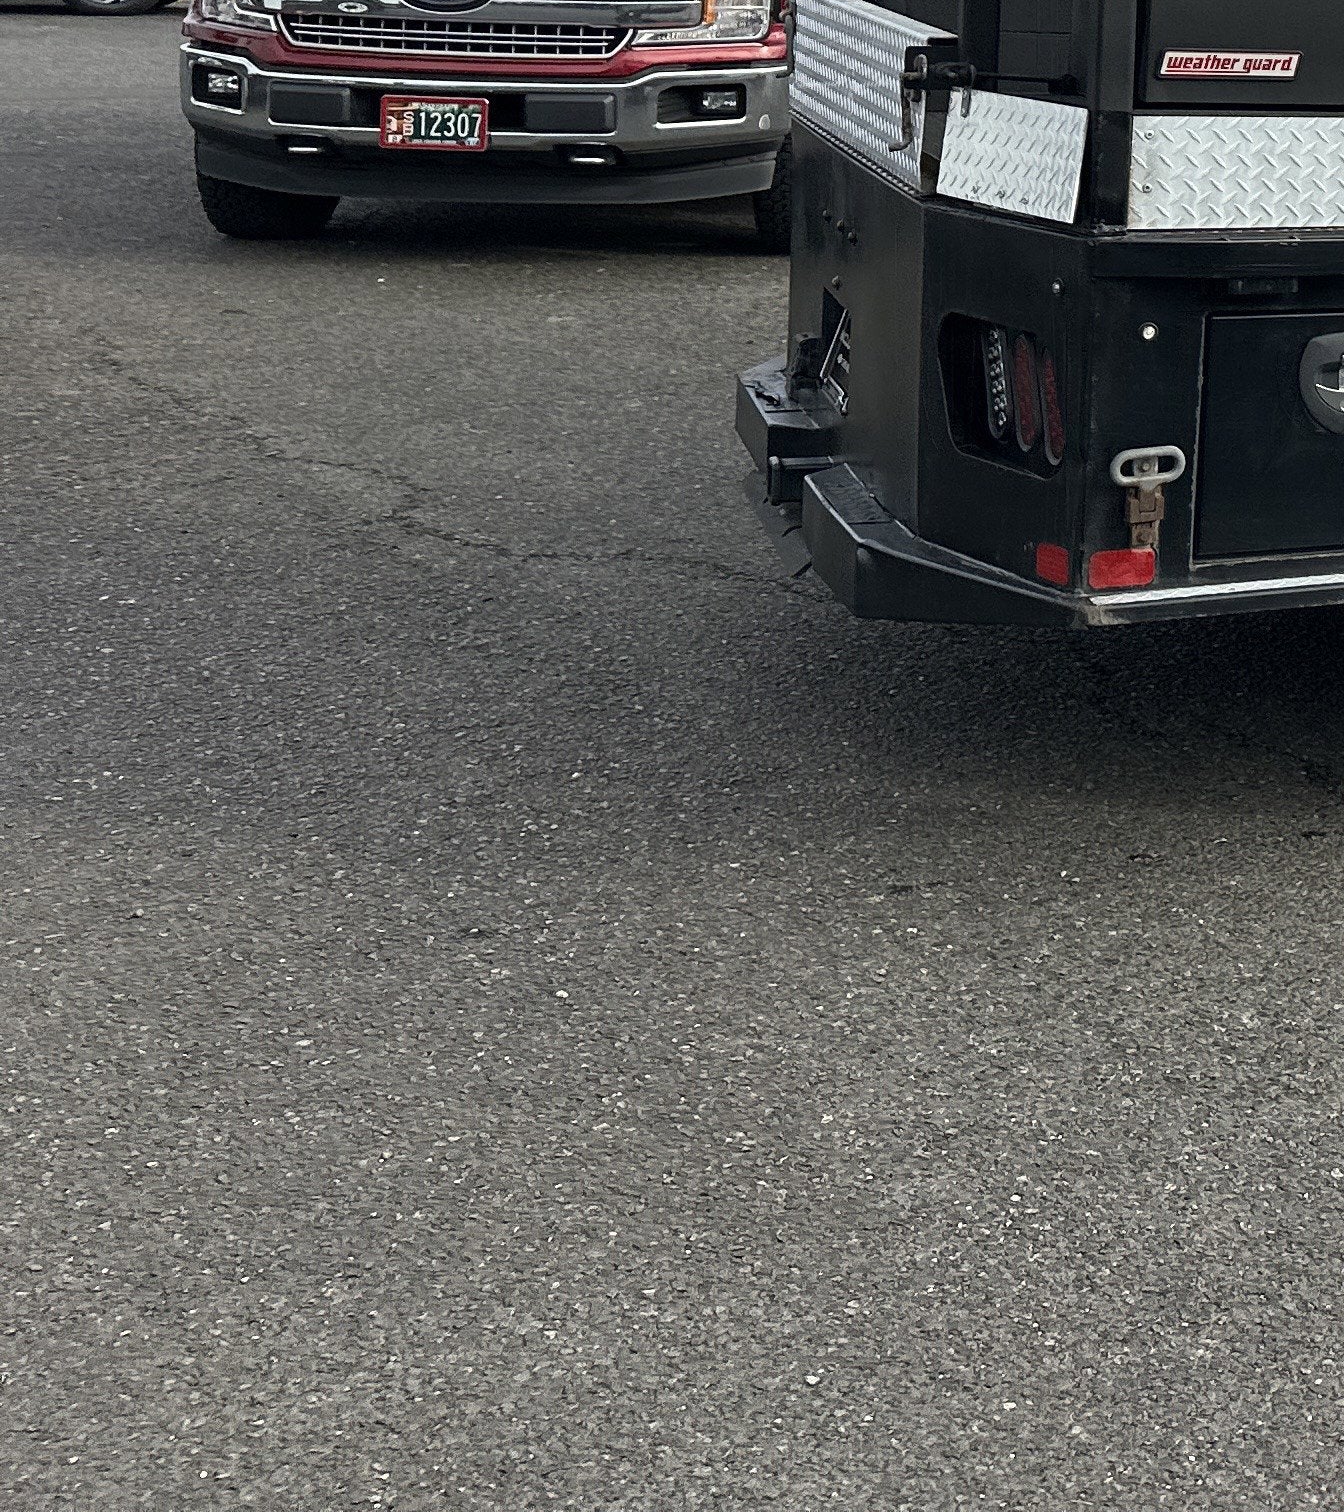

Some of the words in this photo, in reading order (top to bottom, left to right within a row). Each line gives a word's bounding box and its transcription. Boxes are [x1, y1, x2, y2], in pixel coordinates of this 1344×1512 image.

[1166, 54, 1240, 70] weather
[1243, 56, 1294, 73] guard
[420, 112, 482, 137] 12307
